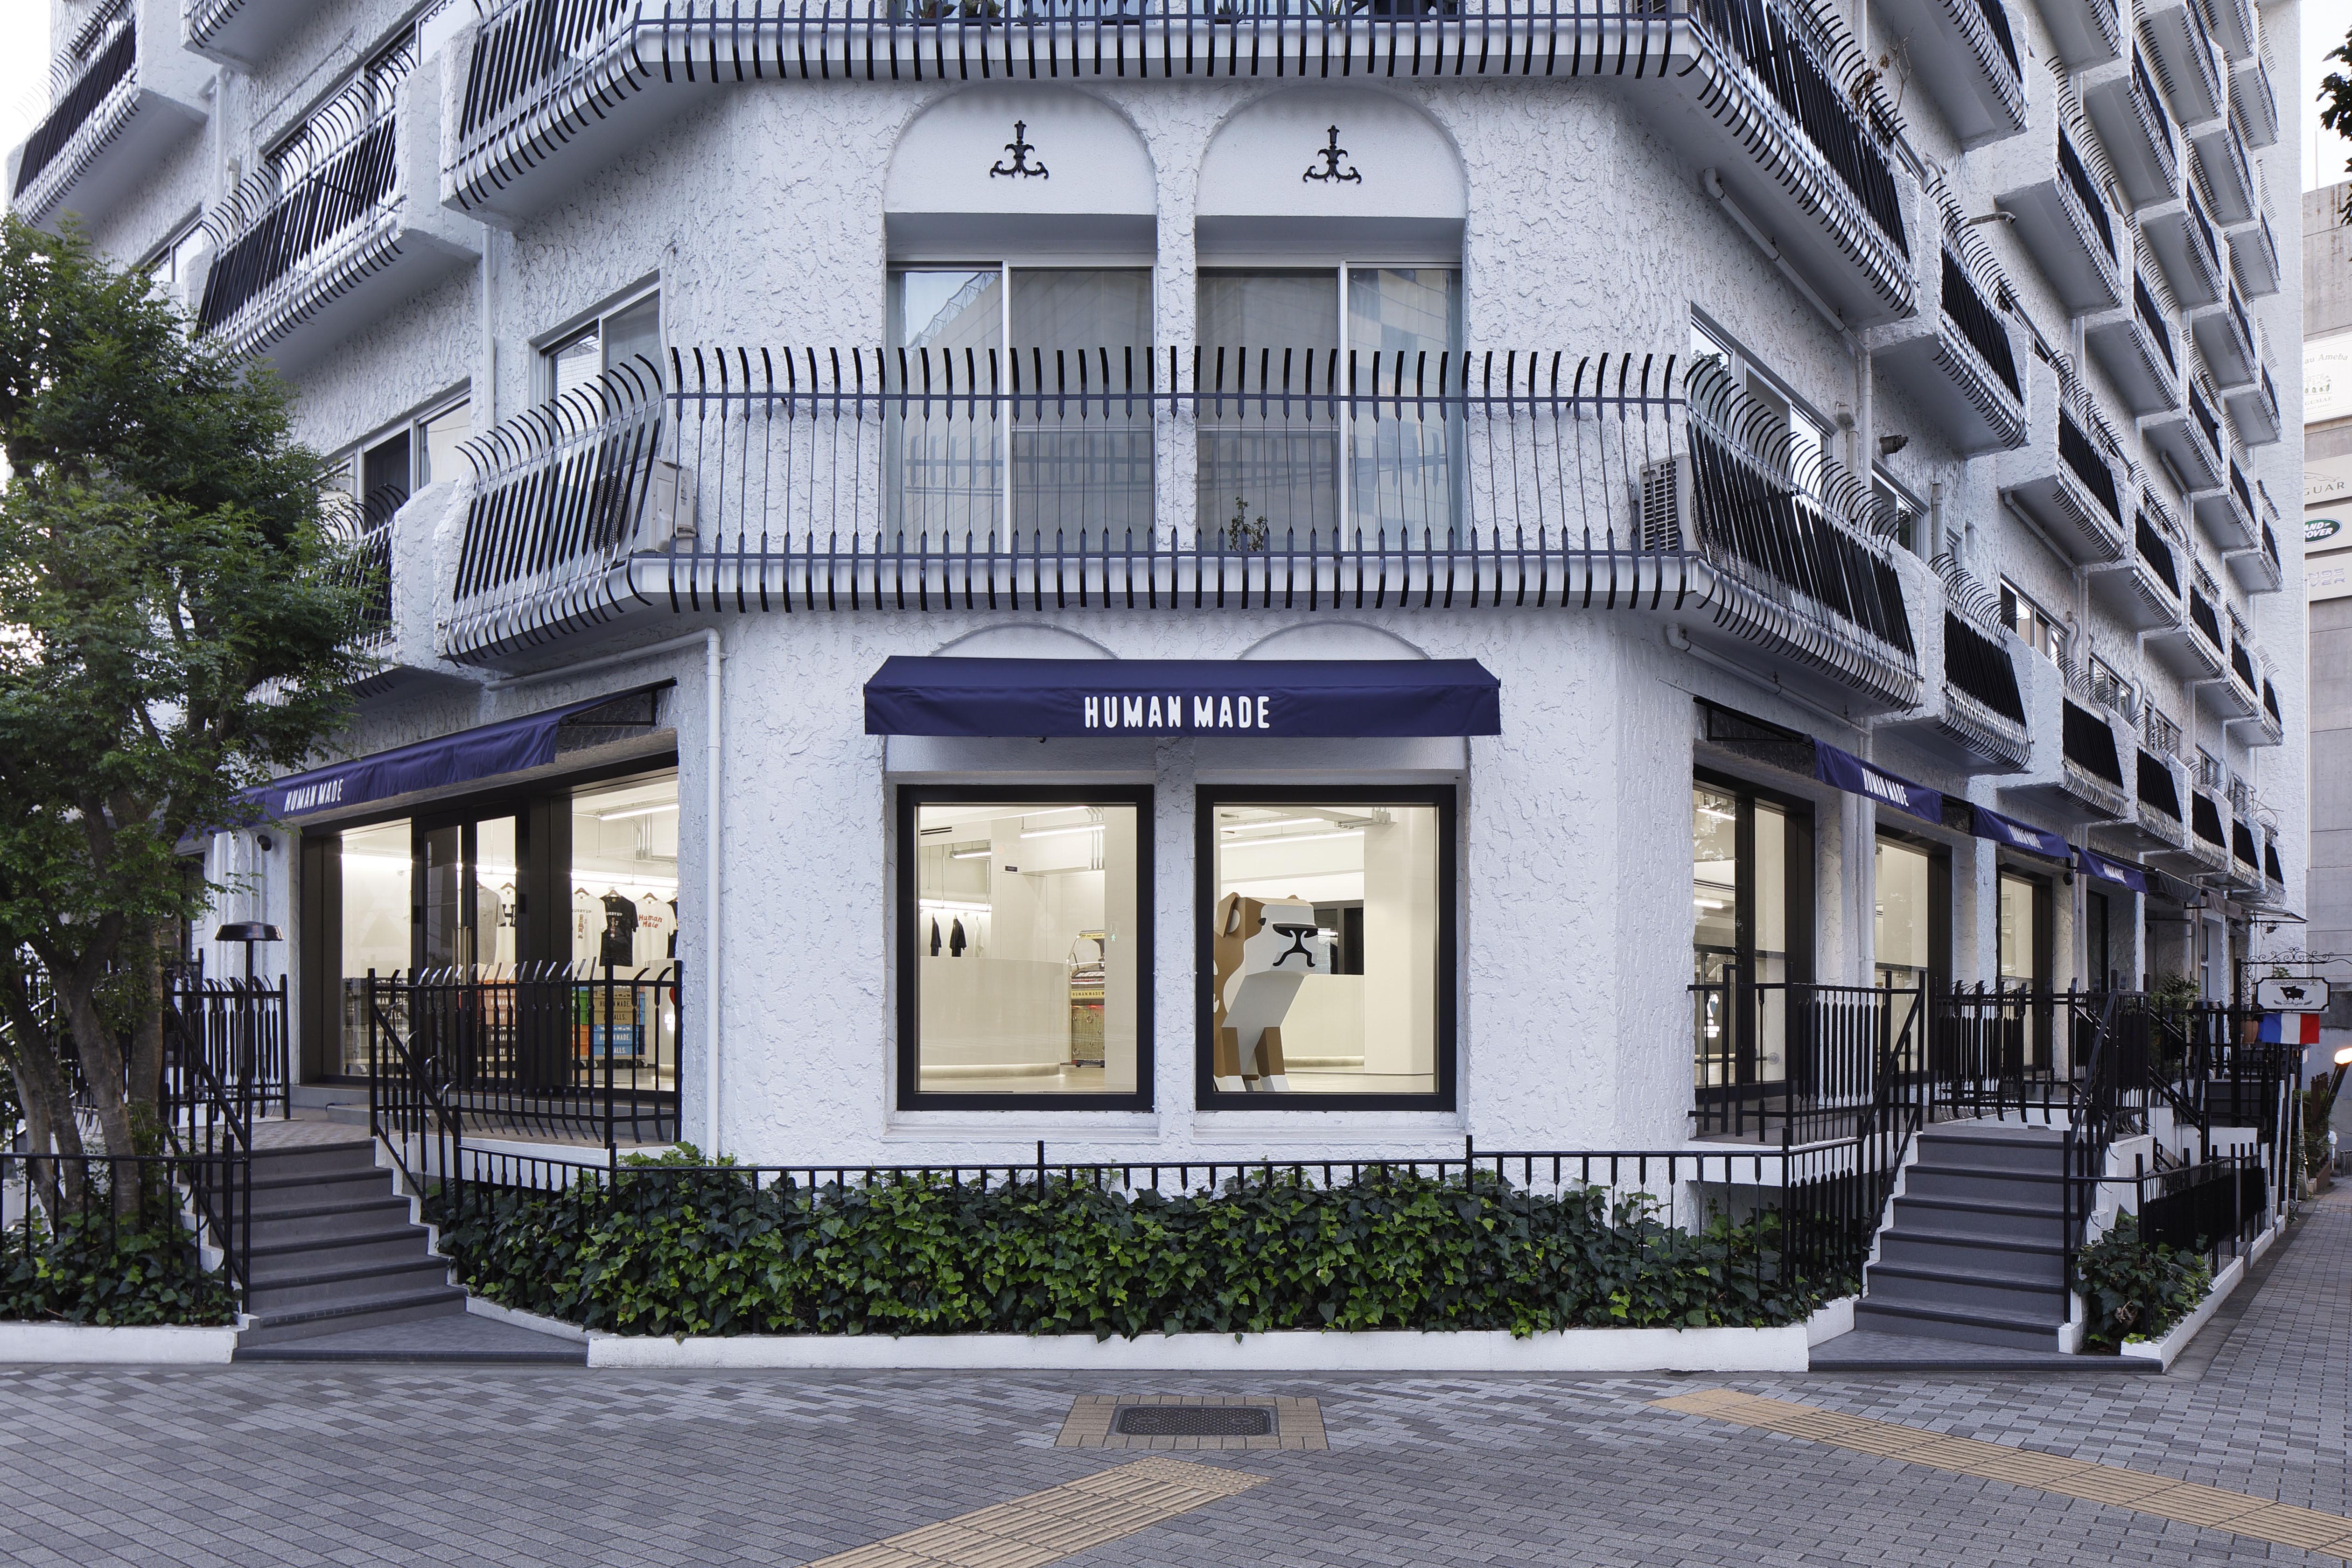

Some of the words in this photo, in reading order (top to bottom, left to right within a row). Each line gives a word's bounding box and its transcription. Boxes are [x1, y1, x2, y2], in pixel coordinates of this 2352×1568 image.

[2304, 482, 2345, 496] GUAR
[2304, 522, 2324, 531] AND
[2304, 527, 2333, 538] OVER
[1085, 695, 1182, 728] HUMAN
[1194, 695, 1270, 728] MADE
[284, 785, 317, 812] HUMAN
[317, 778, 343, 805] MADE
[1862, 767, 1888, 798] HUMAN
[1885, 779, 1909, 806] MADE
